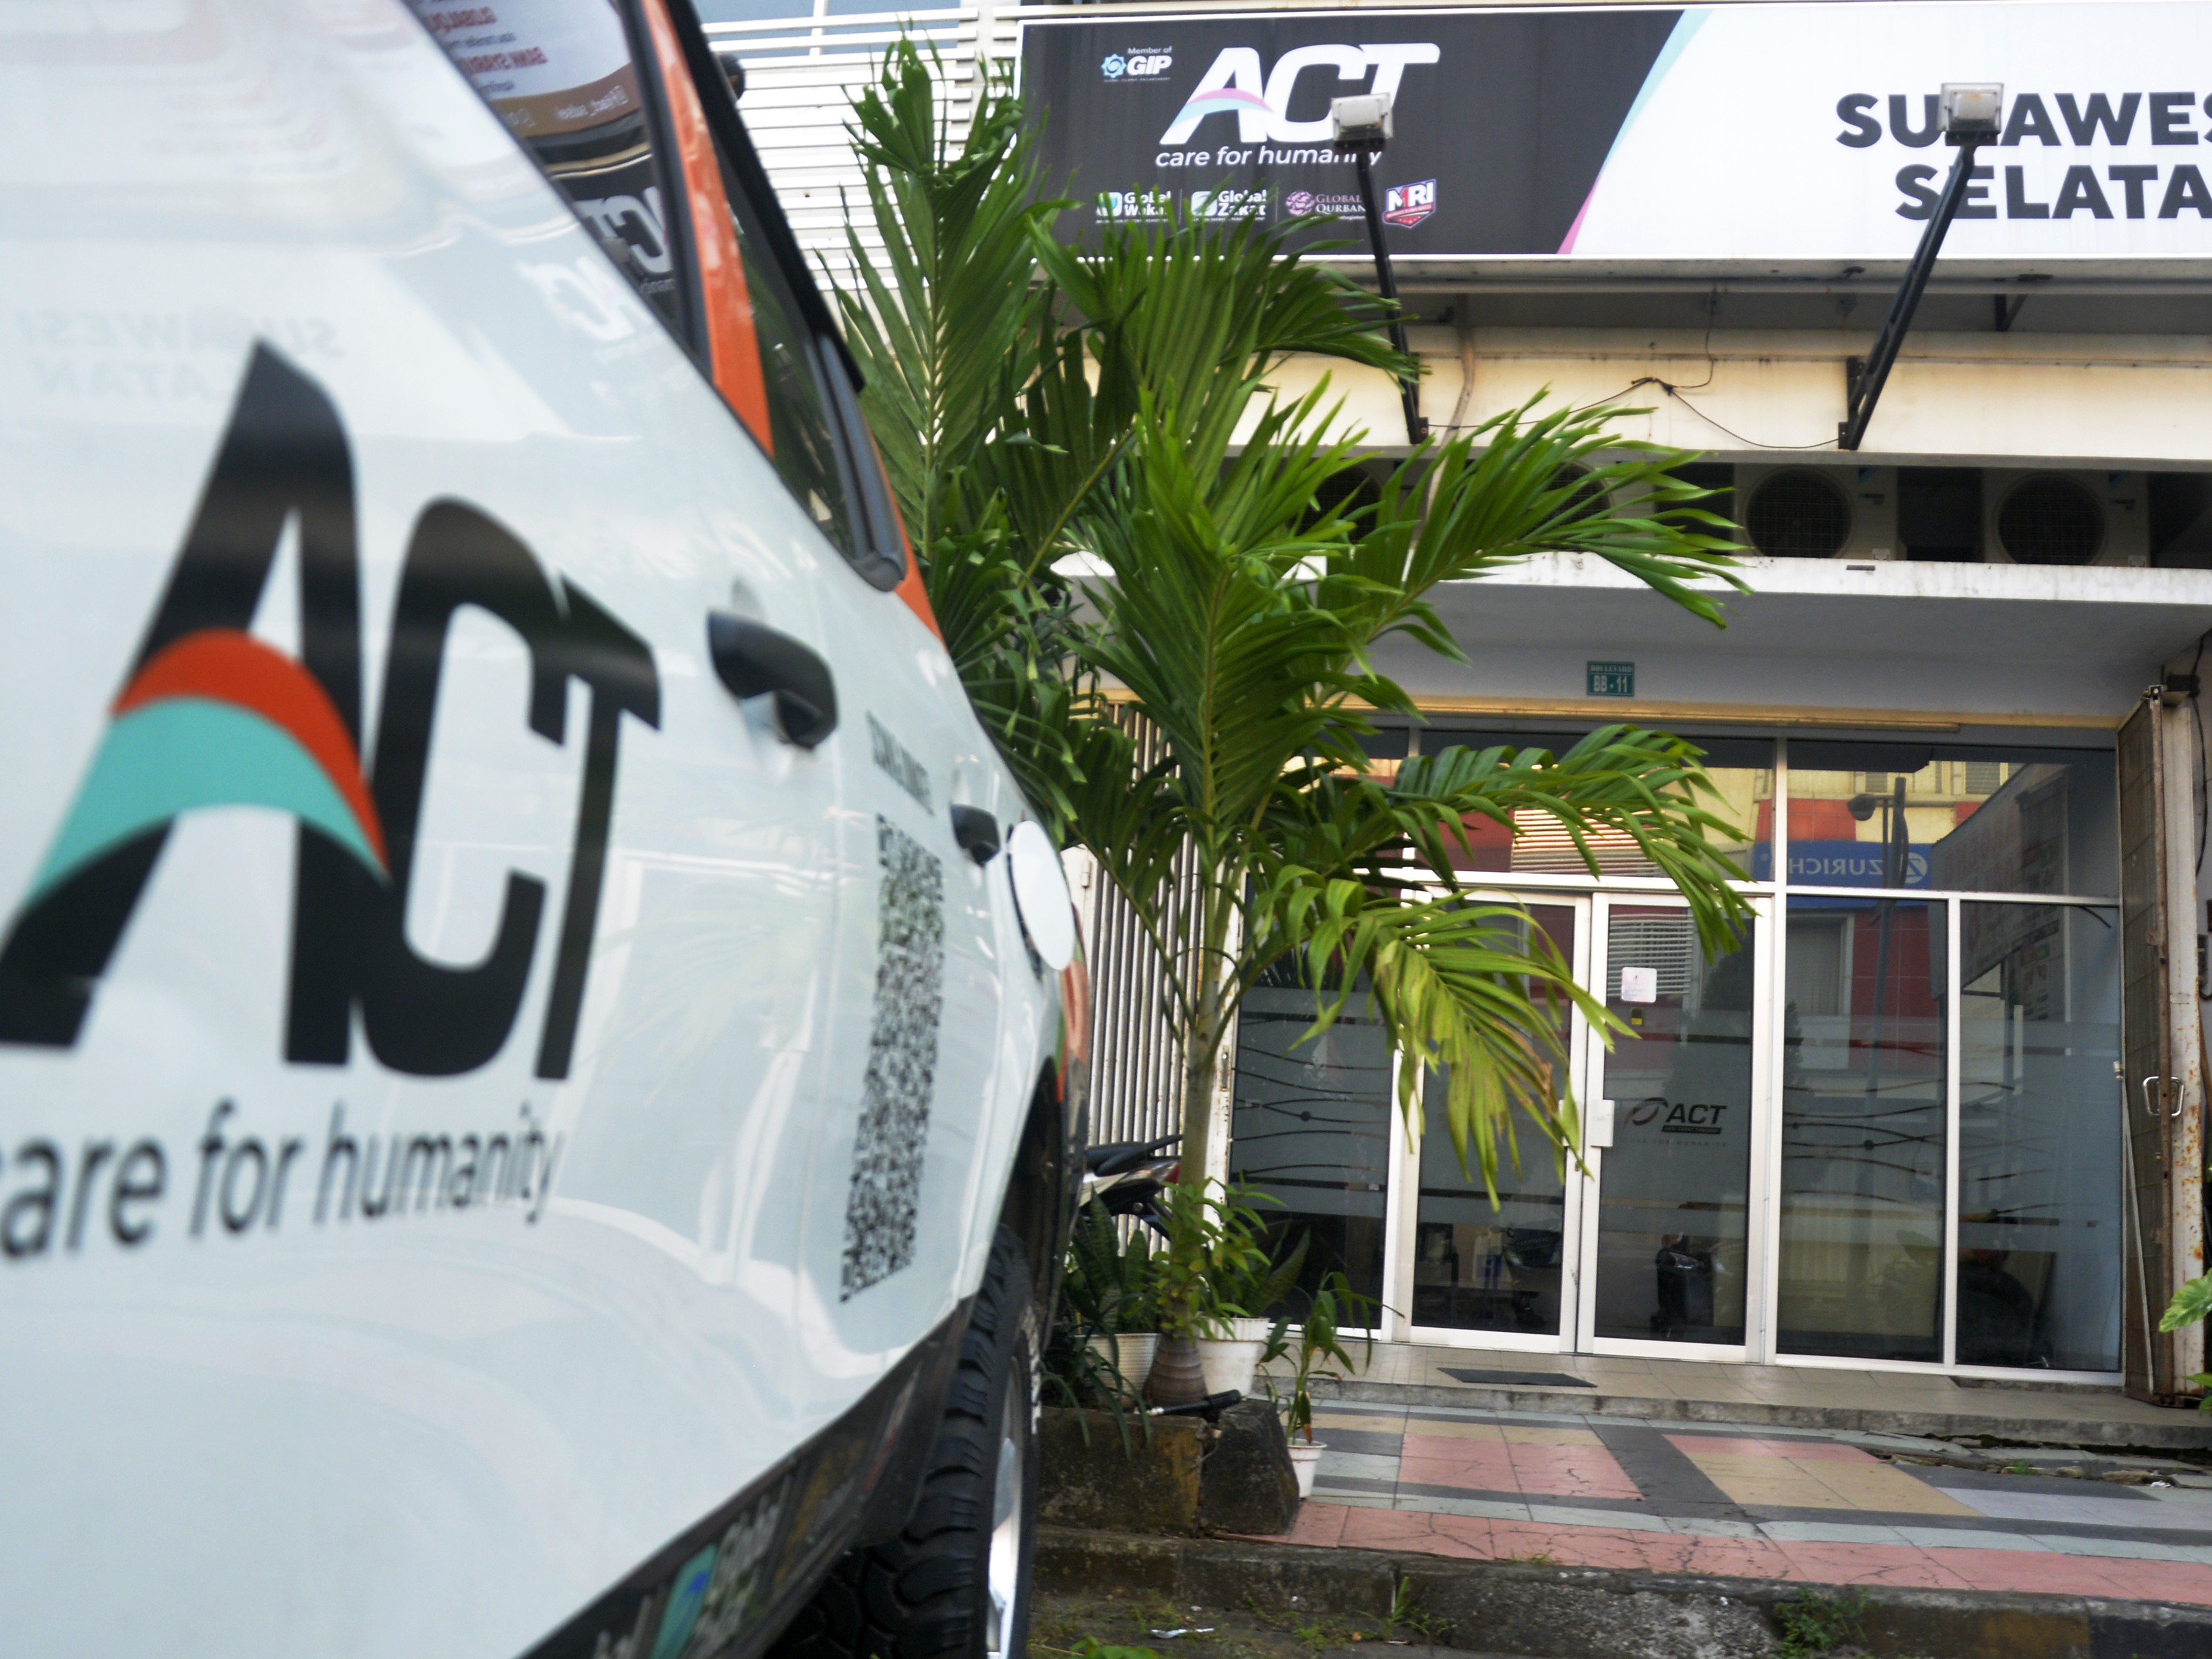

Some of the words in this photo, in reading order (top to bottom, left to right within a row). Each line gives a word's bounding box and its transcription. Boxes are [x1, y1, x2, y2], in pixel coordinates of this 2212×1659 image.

[1127, 55, 1172, 76] GIP
[1159, 43, 1441, 144] ACT
[1835, 92, 2212, 148] SUAWE
[1155, 151, 1210, 167] care
[1217, 146, 1252, 165] for
[1258, 145, 1382, 166] humay
[1315, 194, 1362, 203] GLOBAL
[1315, 204, 1367, 214] QURBAN
[1895, 164, 2212, 220] SELATA
[0, 335, 662, 1081] ACT
[1665, 1103, 1728, 1125] ACT
[0, 1134, 168, 1258] are
[188, 1095, 303, 1241] for
[312, 1099, 565, 1226] humanity
